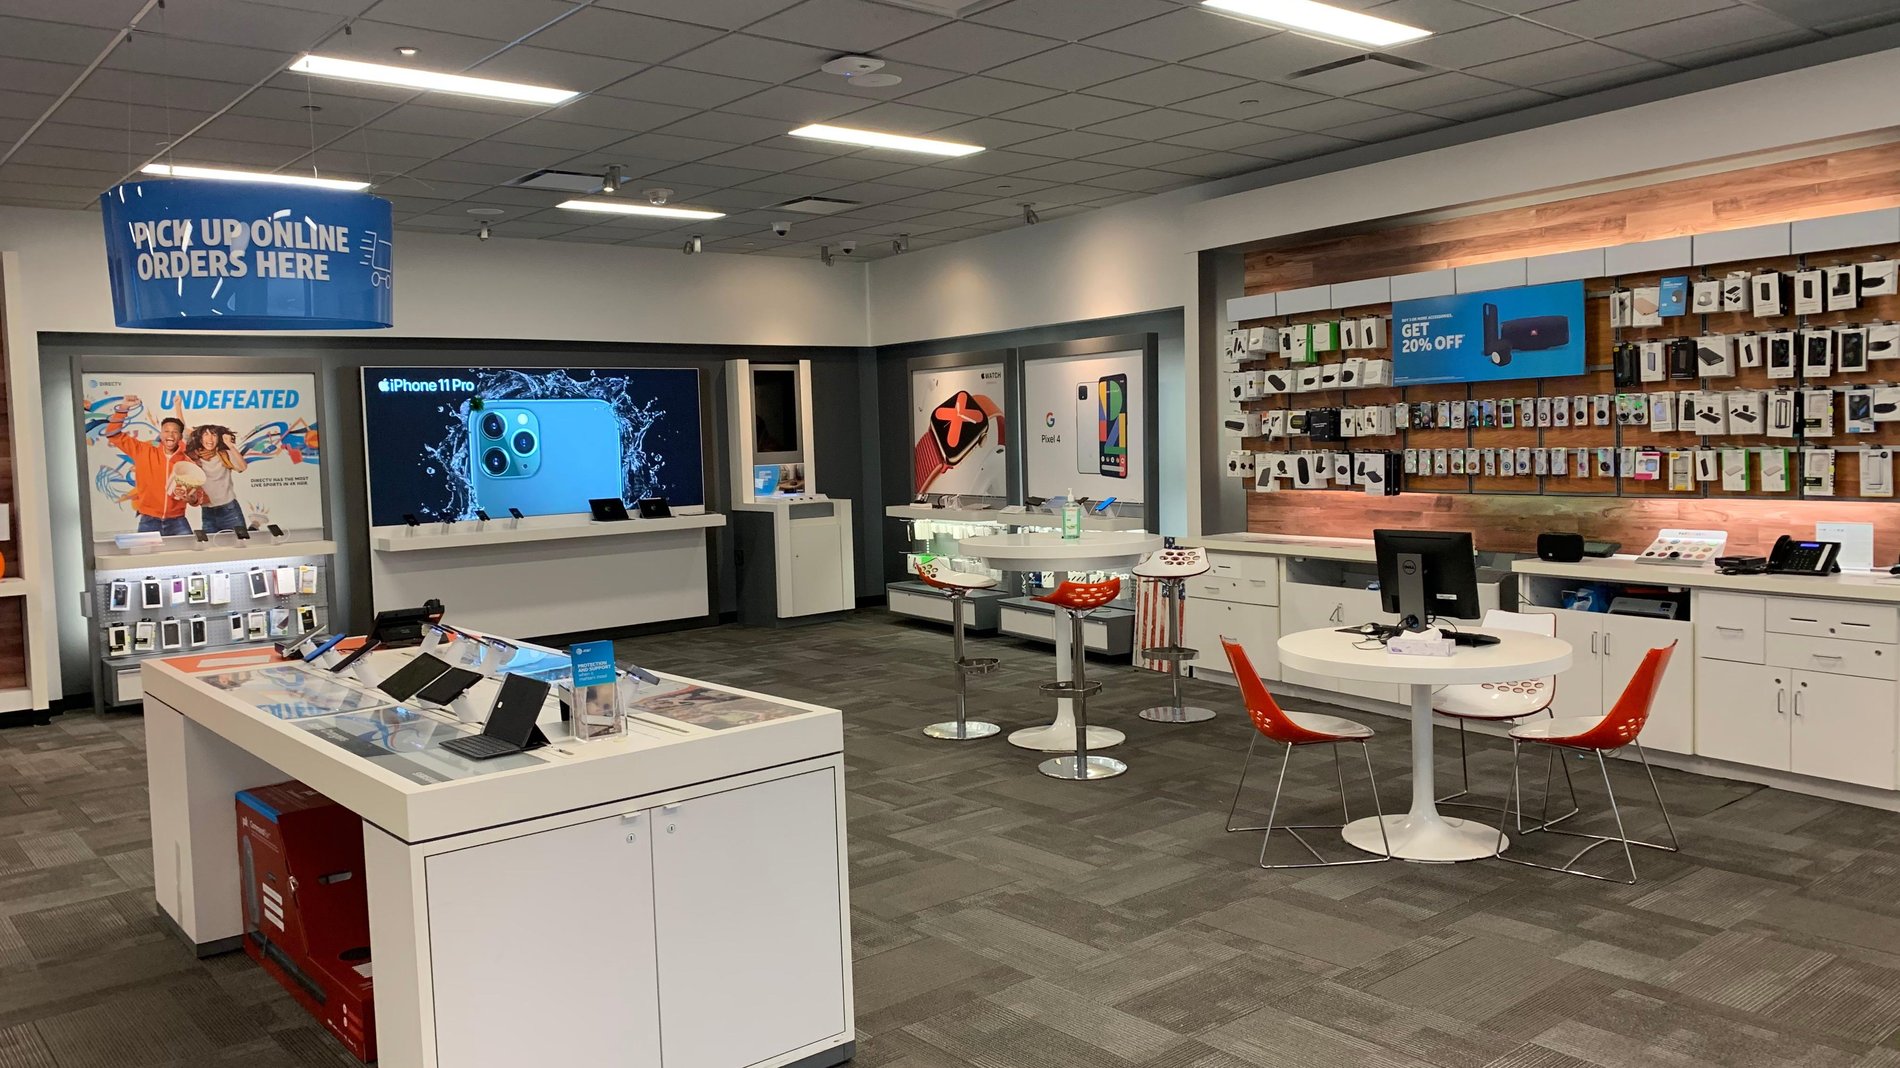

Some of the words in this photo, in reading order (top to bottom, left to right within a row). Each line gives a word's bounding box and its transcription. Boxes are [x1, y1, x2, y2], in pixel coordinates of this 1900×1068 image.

[134, 218, 194, 250] PICK
[202, 218, 243, 247] UP
[250, 219, 350, 253] ONLINE
[137, 250, 248, 281] ORDERS
[256, 251, 331, 281] HERE
[1402, 322, 1429, 337] GET
[1402, 338, 1432, 352] 20%
[985, 371, 1002, 379] WATCH
[389, 378, 438, 392] iPhone
[437, 378, 450, 392] 11
[451, 378, 475, 392] Pro
[160, 389, 300, 411] UNDEFEATED
[1041, 434, 1056, 444] Pixel
[1056, 434, 1061, 443] 4
[577, 661, 607, 669] PROTECTION
